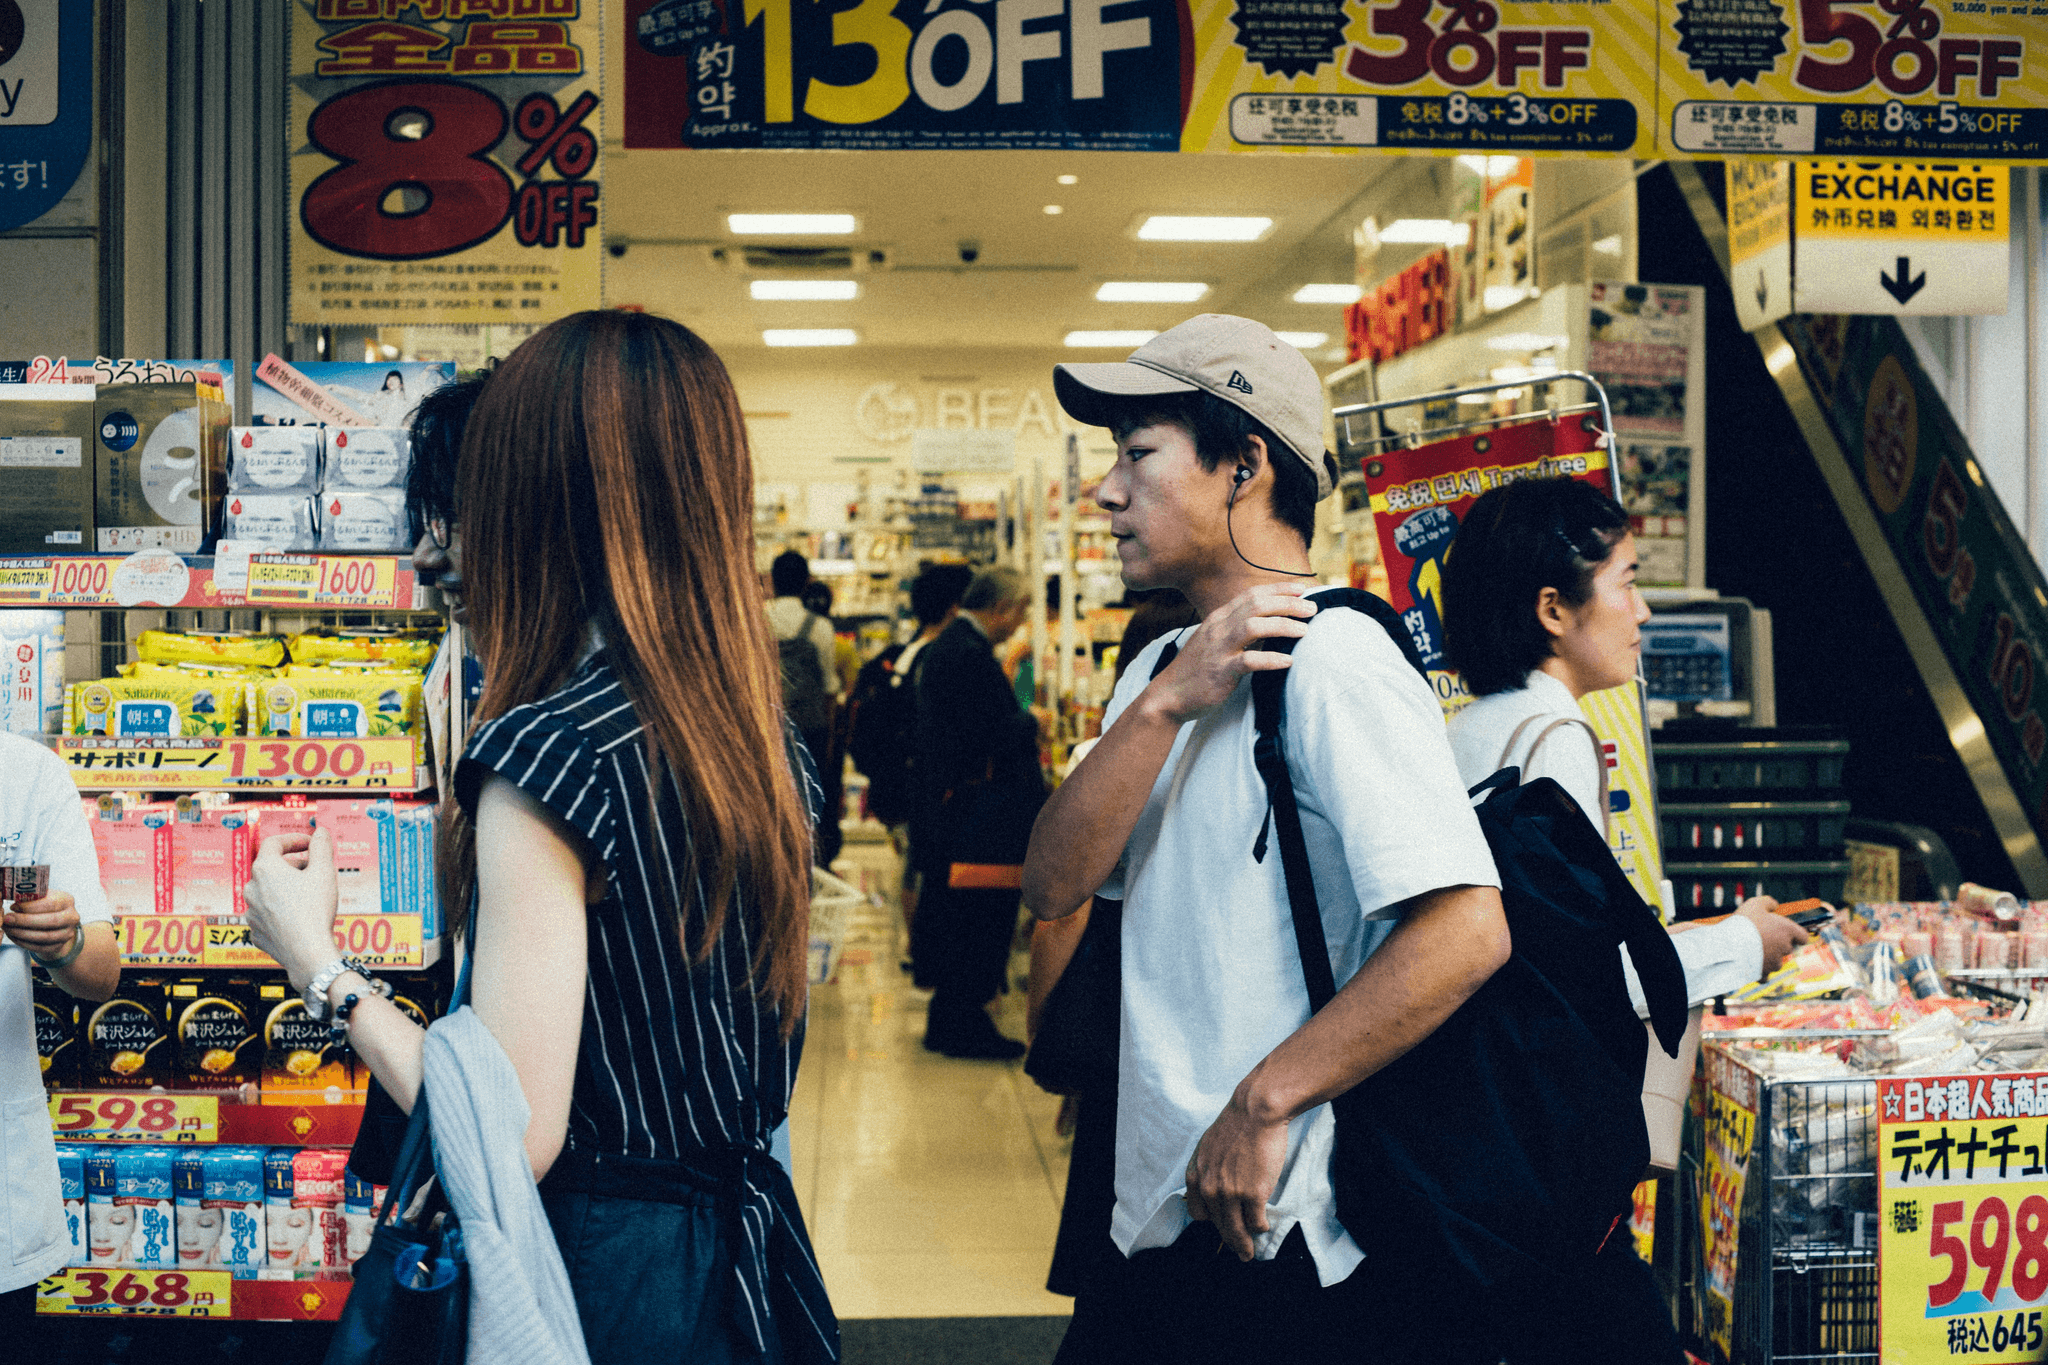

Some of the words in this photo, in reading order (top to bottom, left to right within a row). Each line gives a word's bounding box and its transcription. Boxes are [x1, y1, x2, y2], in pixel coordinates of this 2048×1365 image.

[317, 22, 582, 75] 全品
[743, 0, 913, 124] 13
[911, 0, 1151, 112] OFF
[1429, 30, 1590, 87] OFF
[1875, 37, 2022, 97] OFF
[697, 81, 736, 119] 약
[301, 79, 600, 261] 8%
[1811, 174, 1996, 203] EXCHANGE
[513, 181, 599, 248] OFF
[33, 357, 69, 384] 24
[937, 387, 1064, 437] BEA
[52, 562, 107, 594] 1000
[319, 560, 375, 595] 1600
[68, 751, 219, 768] サボリーノ
[229, 742, 365, 778] 1300
[125, 919, 205, 955] 1200
[333, 918, 393, 954] 500
[271, 1023, 331, 1040] 贅沢ジュレ
[57, 1097, 178, 1132] 598
[1904, 1076, 2048, 1122] 日本超人気商品
[1892, 1124, 2048, 1183] デオナチュ
[1928, 1194, 2048, 1309] 598
[72, 1272, 191, 1307] 368
